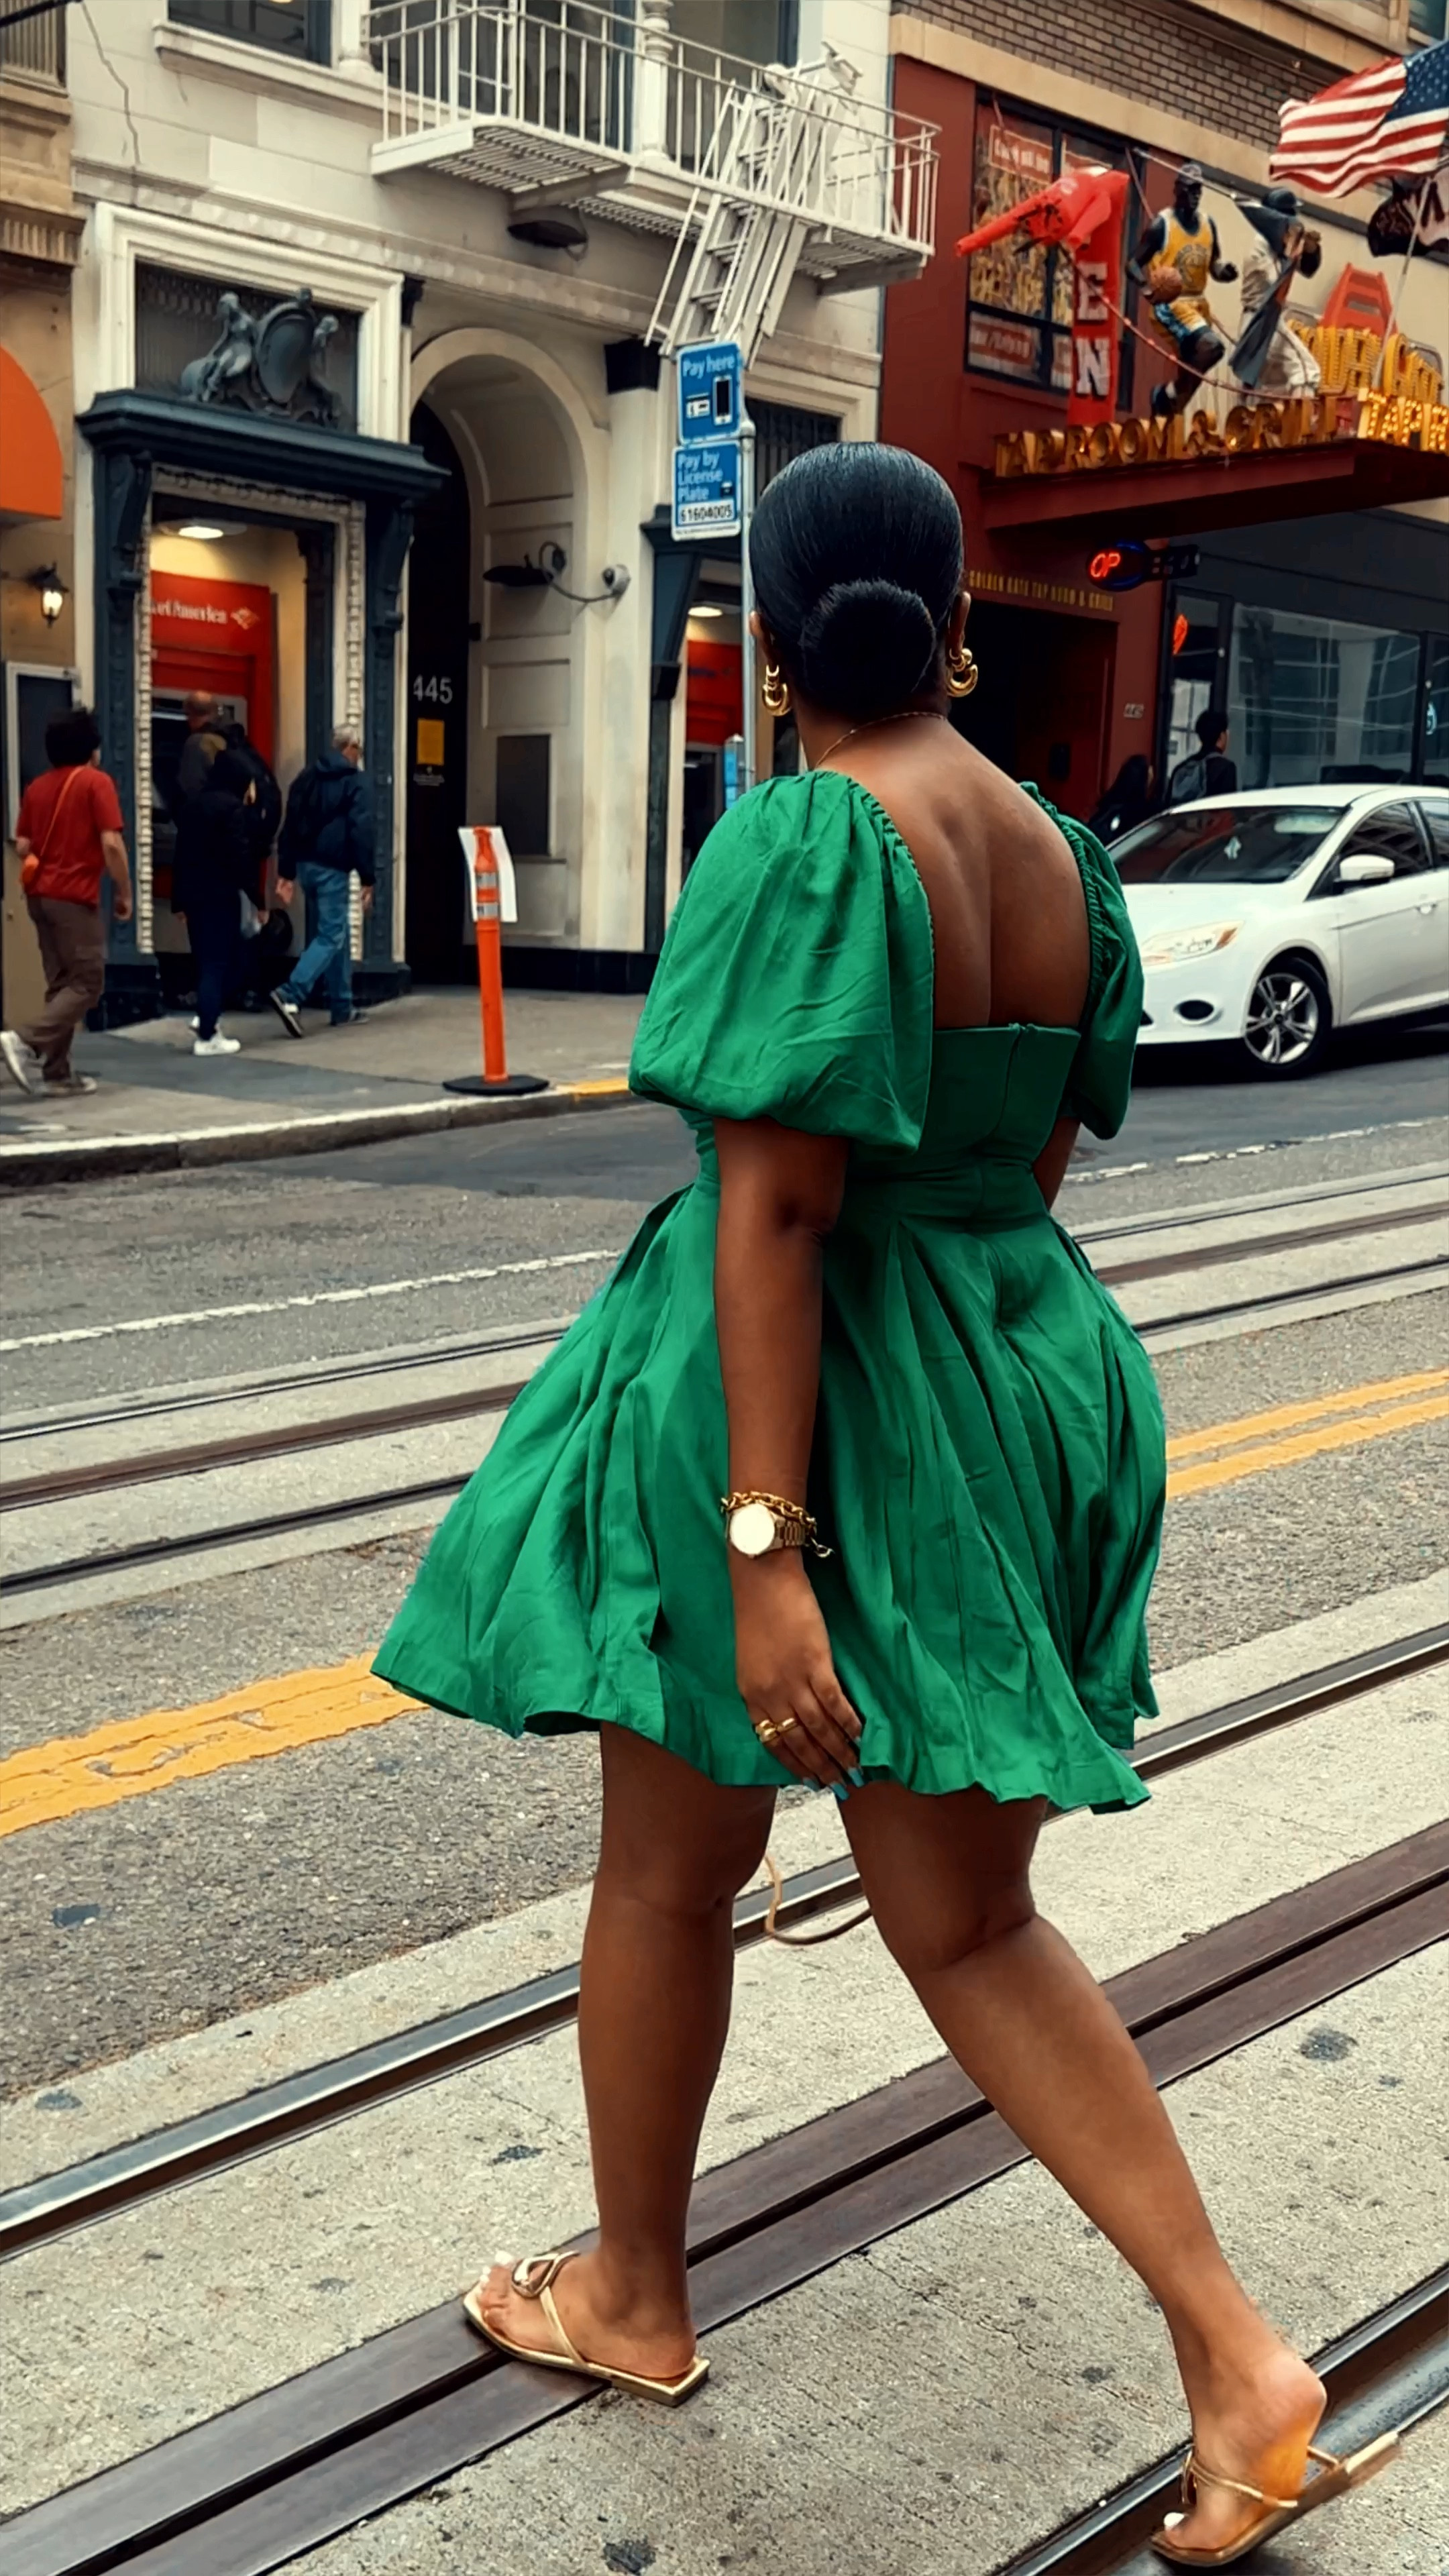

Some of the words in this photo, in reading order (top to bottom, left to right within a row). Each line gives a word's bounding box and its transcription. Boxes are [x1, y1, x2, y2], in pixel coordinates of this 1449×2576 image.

[1075, 261, 1111, 396] EN
[682, 358, 704, 379] Pay
[706, 354, 735, 373] here
[678, 453, 700, 471] Pay
[702, 450, 720, 470] by
[678, 468, 723, 484] License
[678, 485, 709, 502] Plate
[172, 600, 228, 625] America
[413, 674, 453, 704] 445
